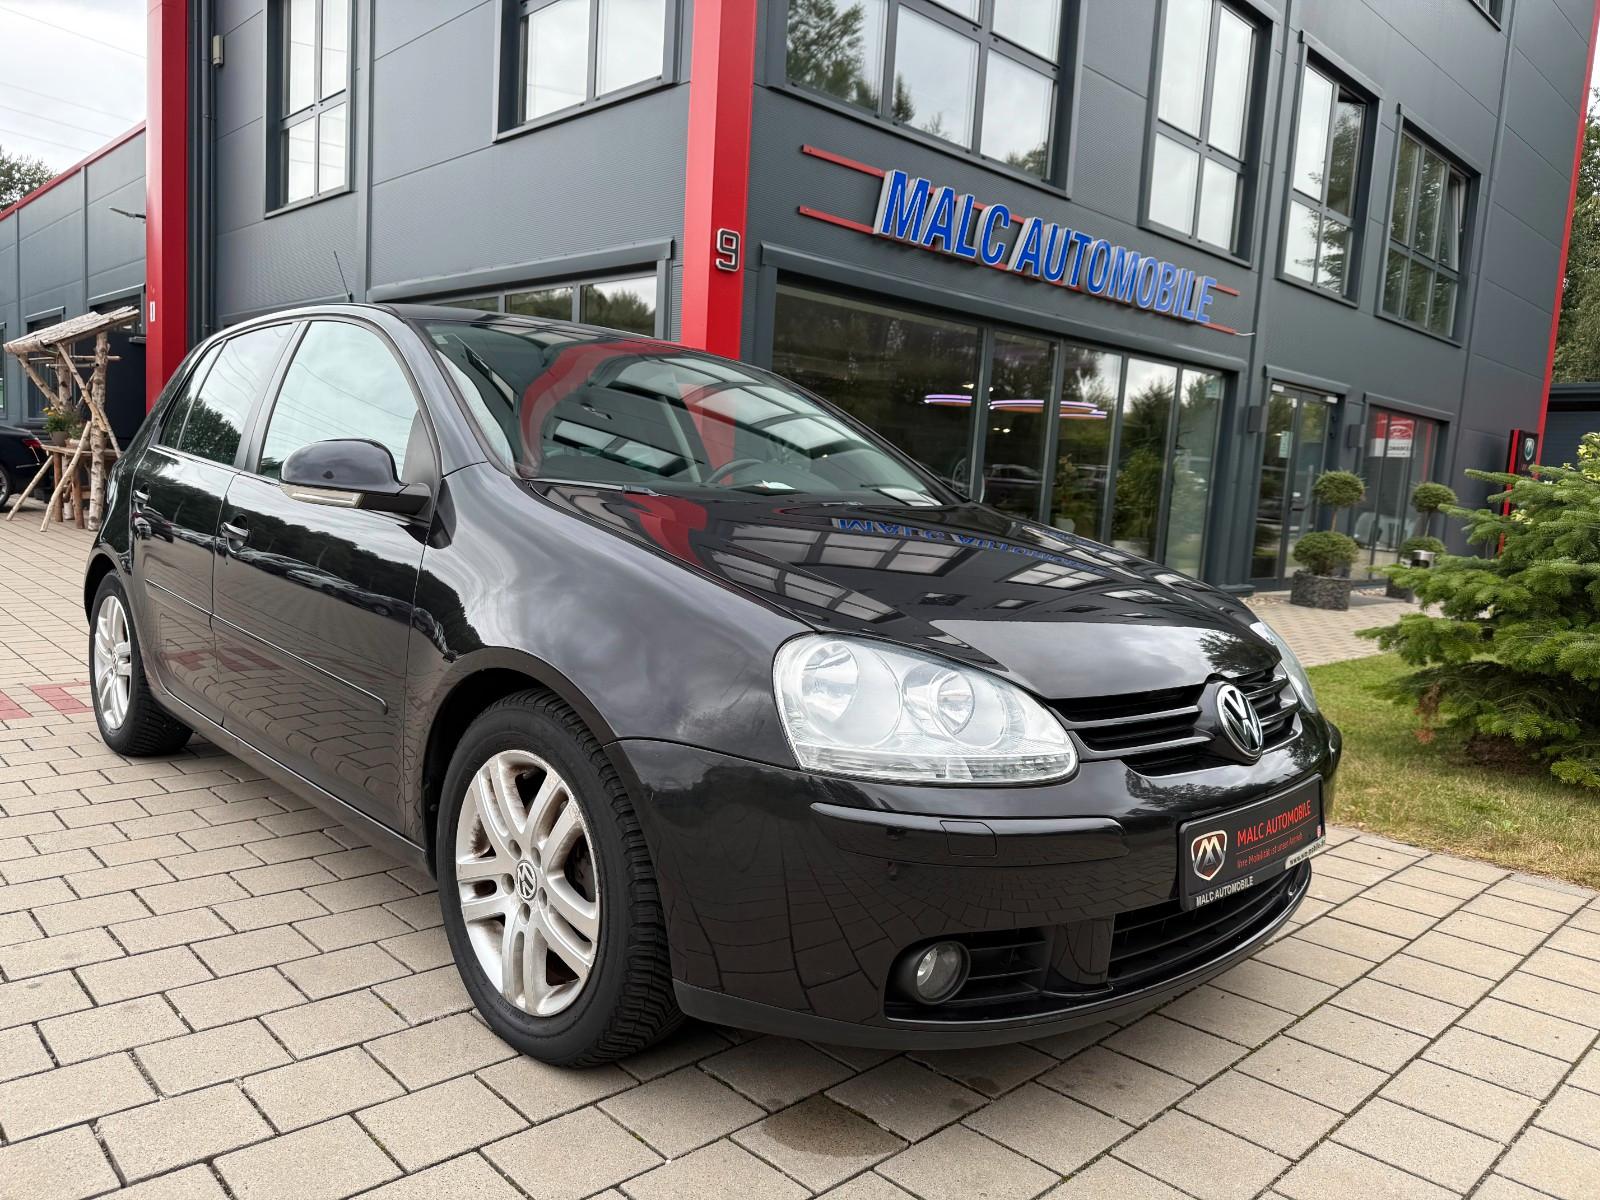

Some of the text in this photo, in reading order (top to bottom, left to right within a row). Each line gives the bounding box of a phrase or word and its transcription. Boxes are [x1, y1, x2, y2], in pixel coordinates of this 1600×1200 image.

[716, 228, 741, 272] 9
[876, 169, 1218, 323] MALC AUTOMOBILE
[1217, 684, 1262, 757] VW
[1237, 822, 1264, 847] MALC
[1266, 800, 1311, 836] AUTOMOBILE
[1196, 876, 1254, 907] MALC AUTOMOBILE
